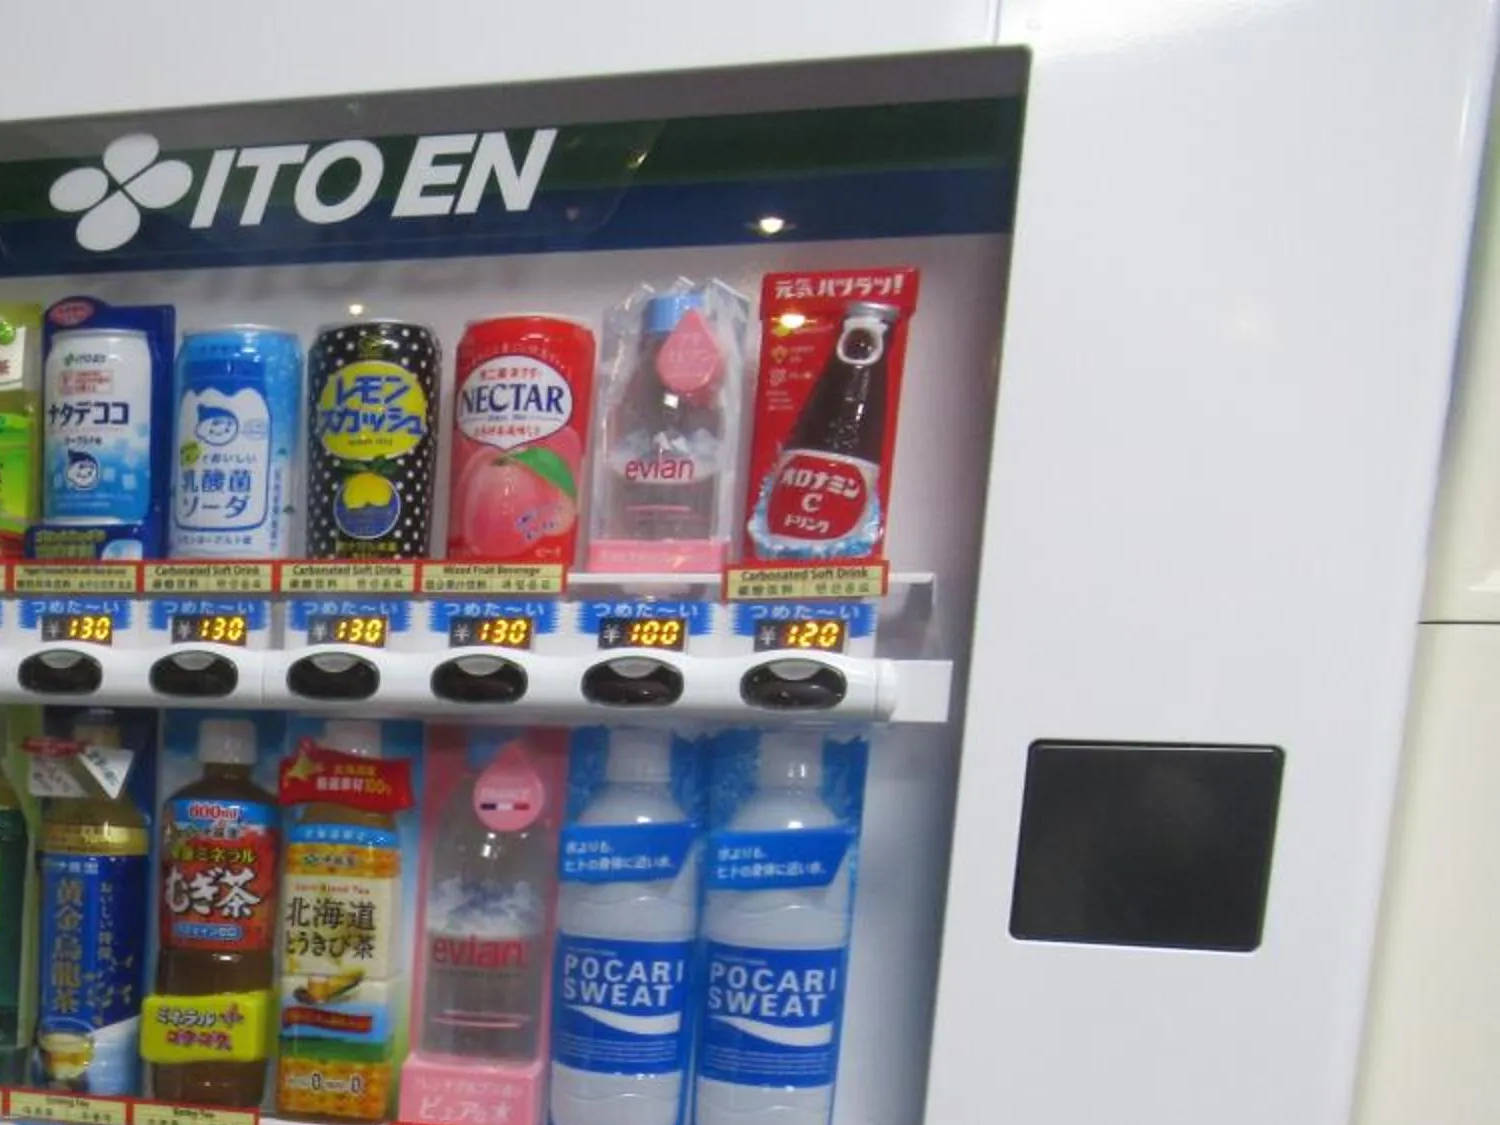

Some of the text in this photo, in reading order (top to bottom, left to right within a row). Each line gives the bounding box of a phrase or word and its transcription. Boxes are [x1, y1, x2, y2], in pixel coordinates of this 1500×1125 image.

[190, 128, 558, 229] ITO EN
[461, 382, 565, 415] NECTAR
[626, 456, 695, 481] evian
[182, 496, 250, 519] ソーダ
[802, 494, 825, 513] C
[165, 865, 261, 919] むぎ茶
[286, 899, 377, 932] 北海道
[433, 935, 526, 970] evian
[563, 955, 684, 985] POCARI
[708, 962, 836, 993] POCARI
[563, 982, 672, 1008] SWEAT
[708, 987, 826, 1018] SWEAT
